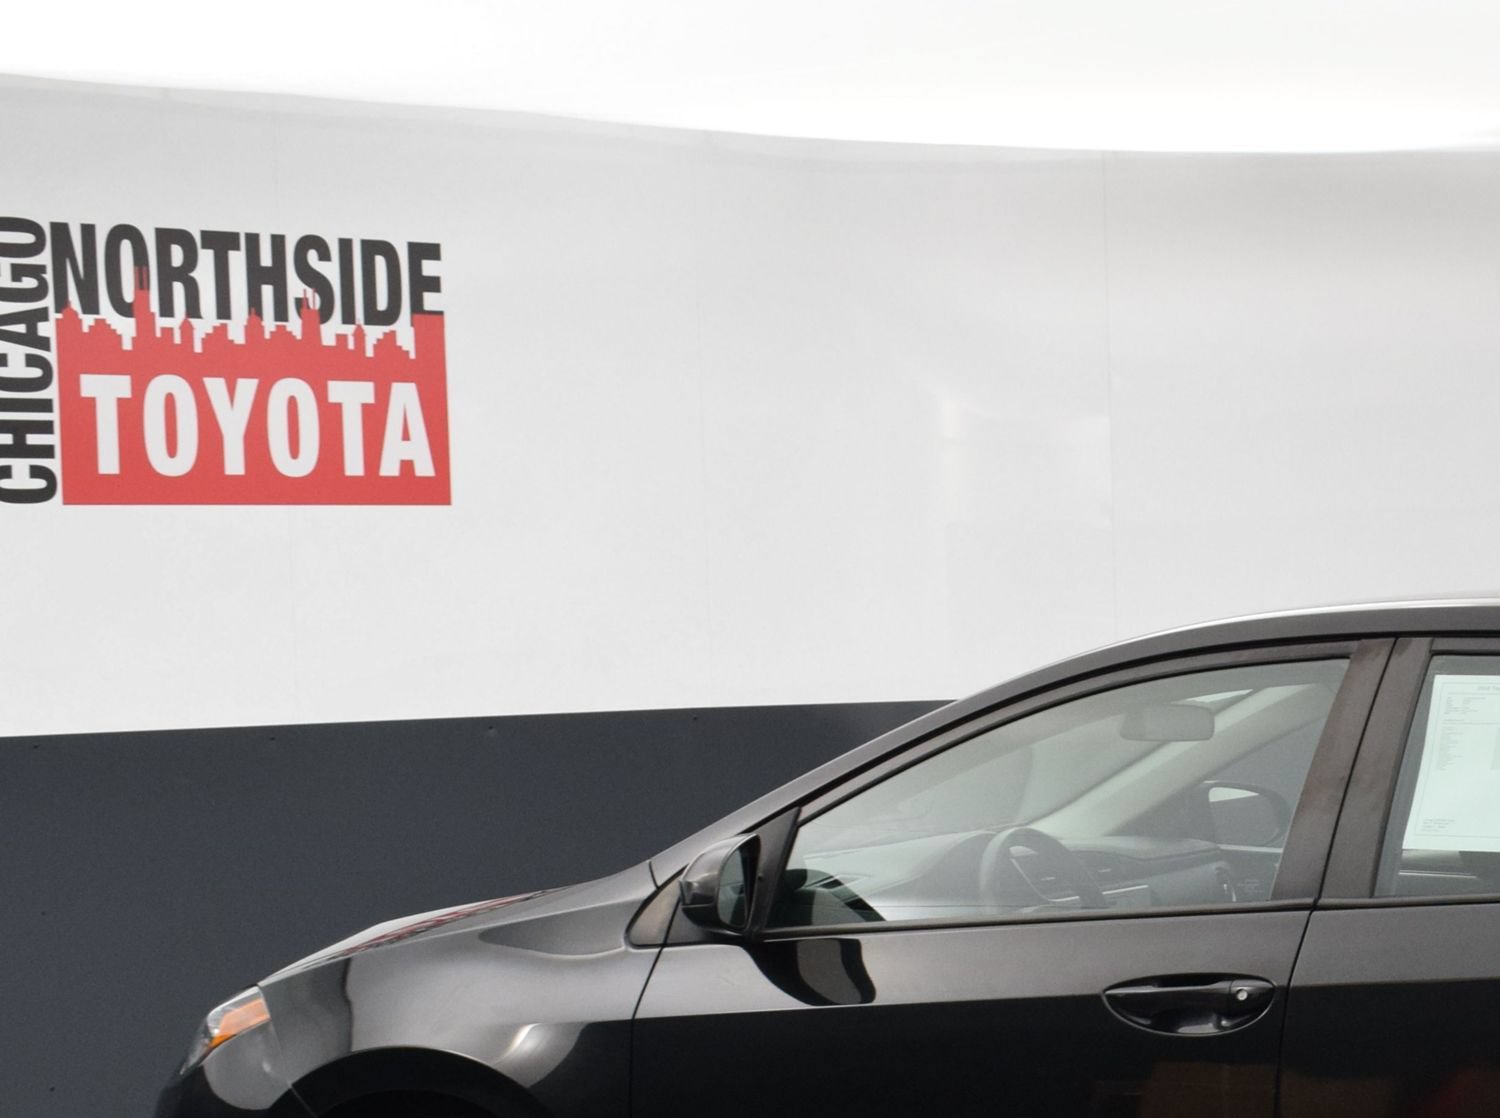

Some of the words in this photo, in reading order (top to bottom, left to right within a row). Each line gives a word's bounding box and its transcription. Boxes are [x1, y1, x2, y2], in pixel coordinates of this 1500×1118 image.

[49, 221, 445, 326] NORTHSIDE
[0, 216, 58, 504] CHICAGO
[79, 373, 436, 477] TOYOTA
